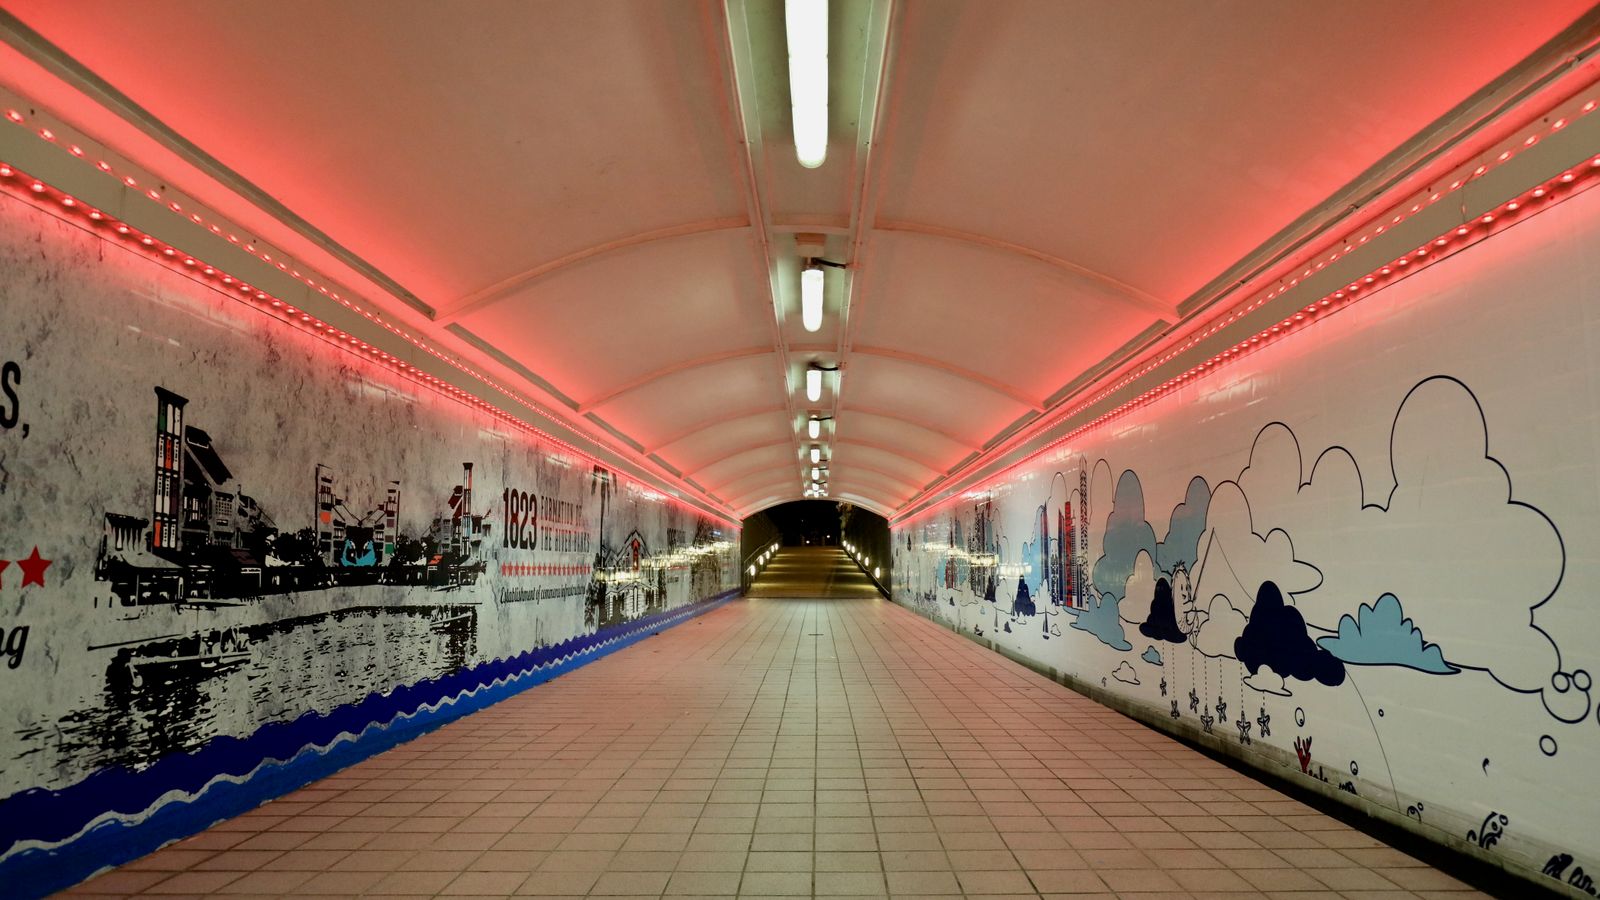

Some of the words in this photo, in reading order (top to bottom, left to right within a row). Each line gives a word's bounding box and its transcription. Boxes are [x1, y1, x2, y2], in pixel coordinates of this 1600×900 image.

[503, 487, 537, 550] 1823
[541, 496, 573, 525] FORMATION
[541, 526, 552, 551] THE
[500, 587, 535, 604] Establishment
